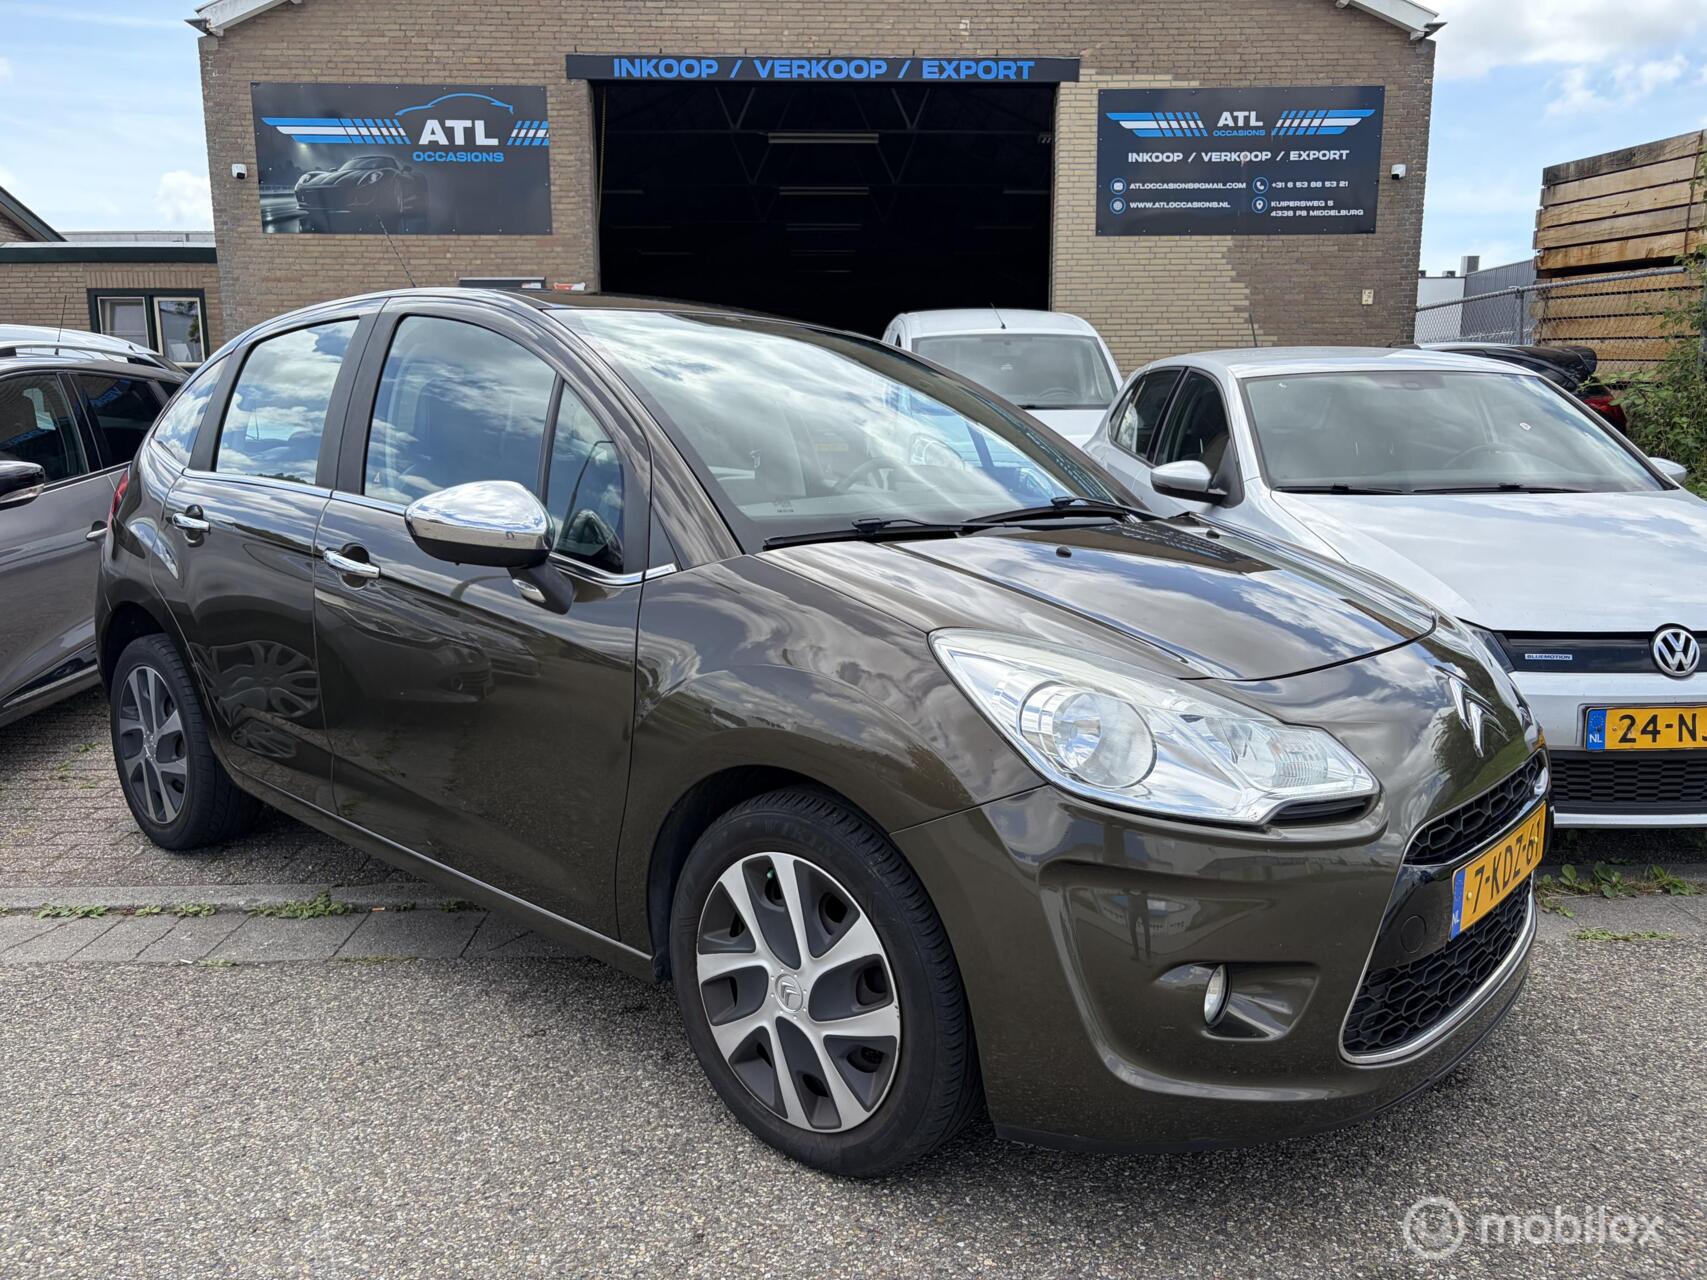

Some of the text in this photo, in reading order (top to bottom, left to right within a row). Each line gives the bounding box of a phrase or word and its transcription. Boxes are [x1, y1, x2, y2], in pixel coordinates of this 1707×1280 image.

[613, 58, 1036, 80] INKOOP / VERKOOP / EXPORT
[1217, 111, 1263, 126] ATL
[419, 120, 498, 145] ATL
[1213, 129, 1267, 138] OCCASIONS
[411, 150, 505, 164] OCCASIONS
[1127, 149, 1350, 163] INKOOP / VERKOOP / EXPORT
[1129, 182, 1247, 190] ATLOCCASIONS@GMAIL.COM
[1271, 181, 1286, 189] +31
[1129, 201, 1232, 209] WWW.ATLOCCASIONS.NL
[1270, 200, 1326, 208] KUIPERSWEG
[1309, 208, 1364, 217] MIDDELBURG
[1618, 713, 1707, 743] 24-N
[1589, 733, 1603, 743] NL
